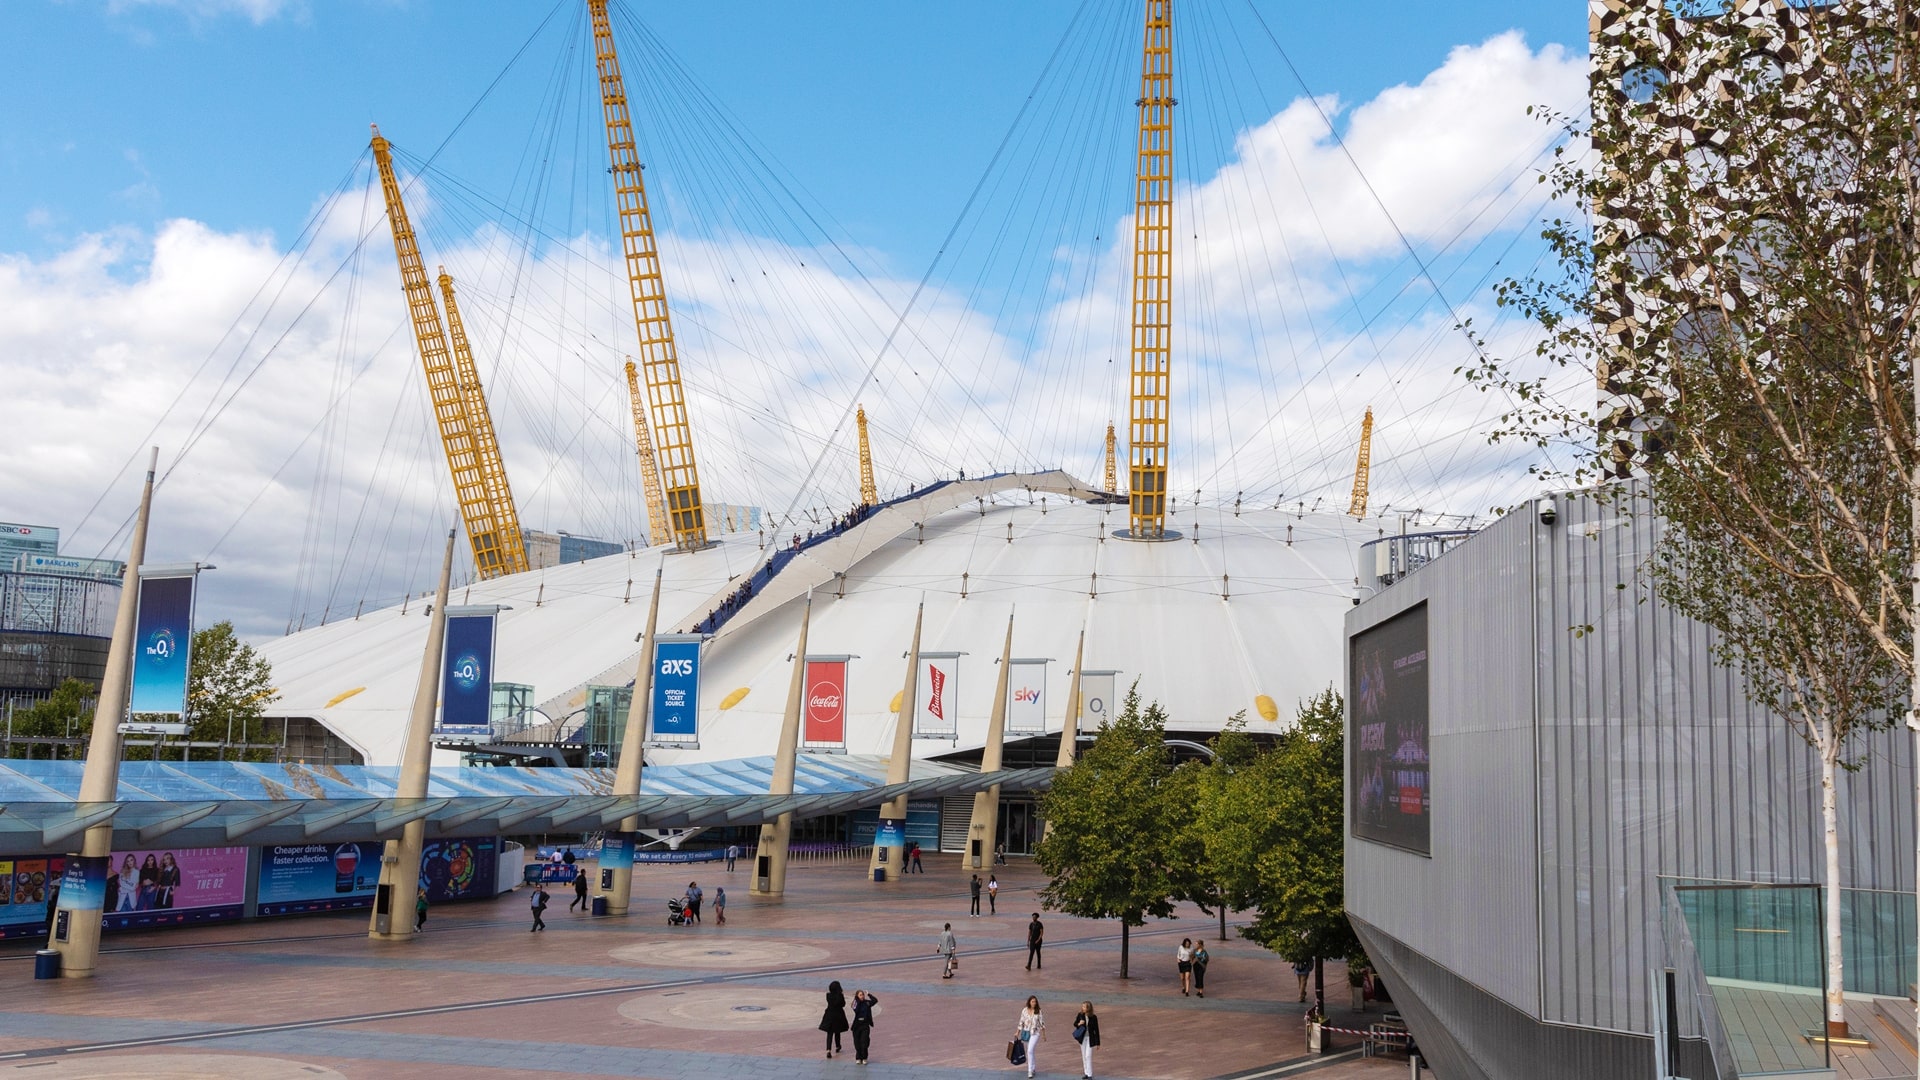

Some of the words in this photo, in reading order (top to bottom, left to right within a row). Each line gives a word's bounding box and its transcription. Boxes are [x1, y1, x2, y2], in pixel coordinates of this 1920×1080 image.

[44, 558, 80, 568] BARCLAYS
[146, 646, 156, 655] The
[156, 639, 169, 658] O2
[453, 670, 463, 678] The
[463, 664, 474, 680] O2
[931, 669, 941, 715] Budweiser
[1015, 686, 1041, 704] sky
[810, 695, 841, 708] Coca-Cola
[274, 846, 303, 855] Cheaper
[304, 845, 328, 853] drinks,
[273, 856, 294, 865] faster
[295, 854, 330, 864] collection.
[68, 869, 78, 877] Every
[196, 879, 212, 890] THE
